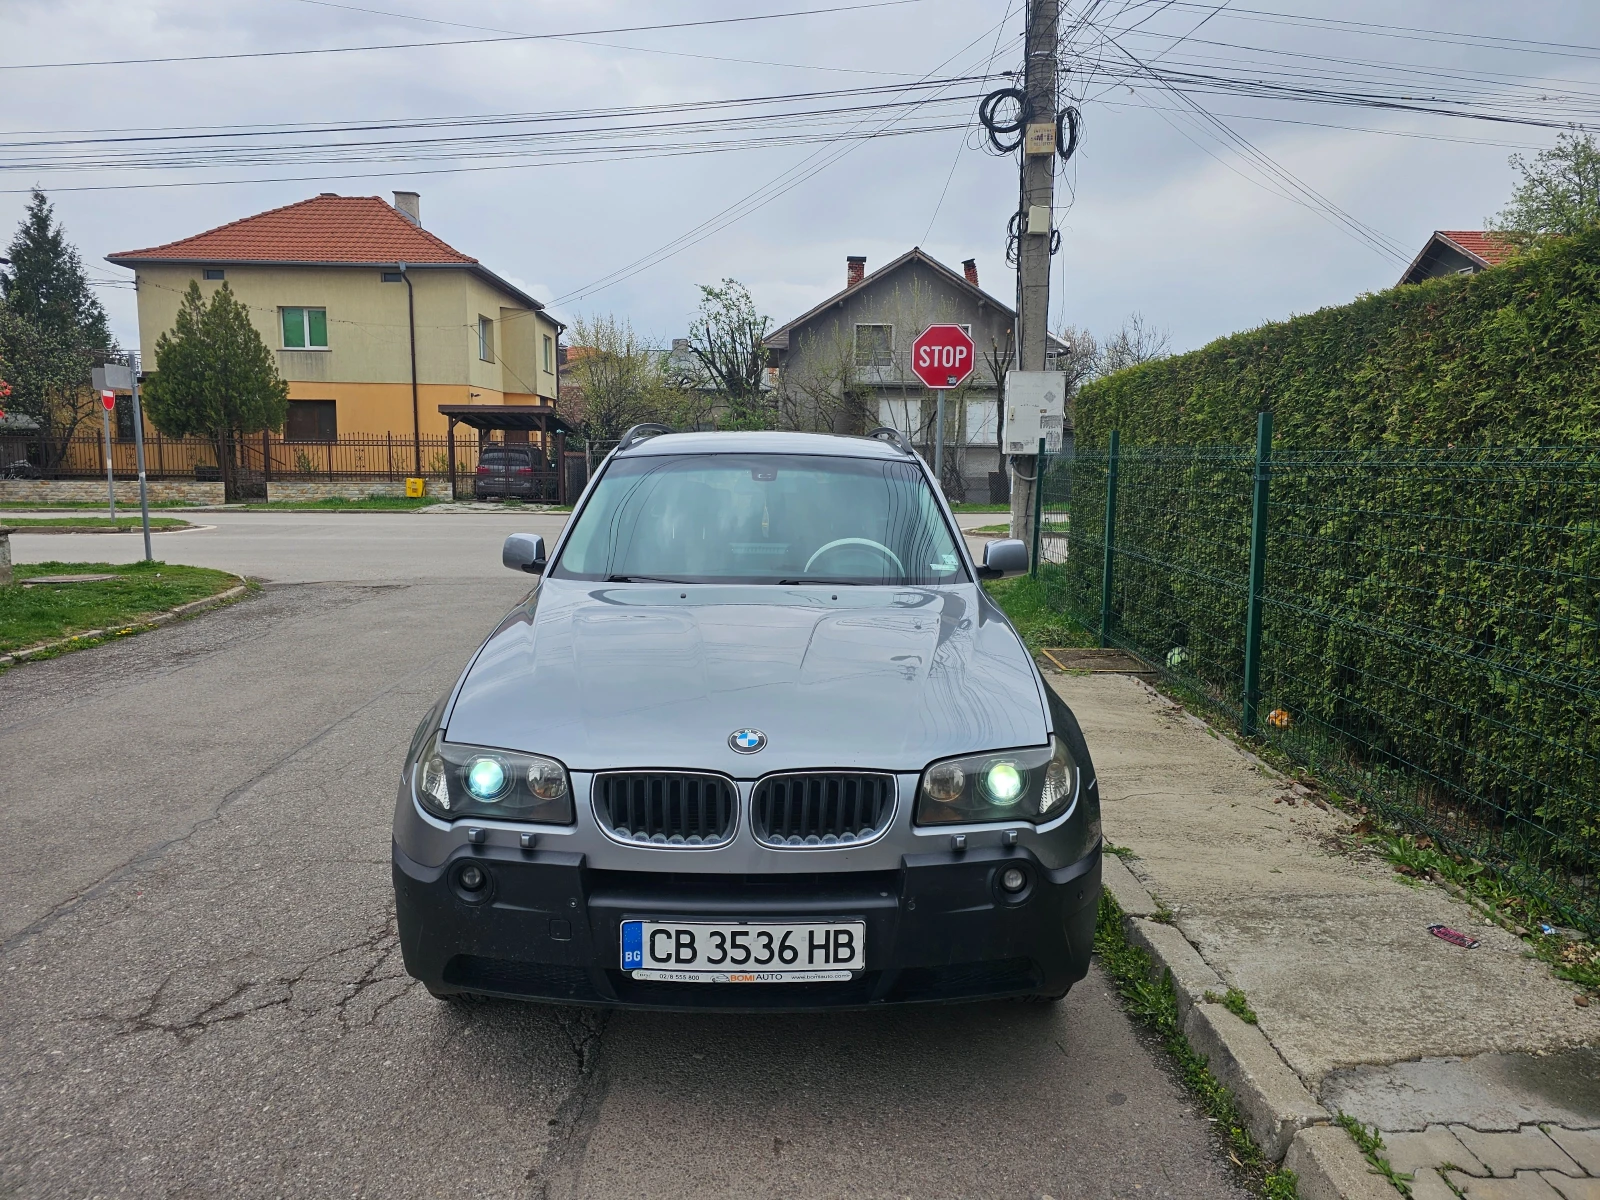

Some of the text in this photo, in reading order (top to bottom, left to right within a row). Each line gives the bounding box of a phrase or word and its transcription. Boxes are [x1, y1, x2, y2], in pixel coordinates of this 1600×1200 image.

[919, 345, 967, 367] STOP
[625, 950, 641, 962] BG
[649, 928, 856, 965] CB 3536 HB
